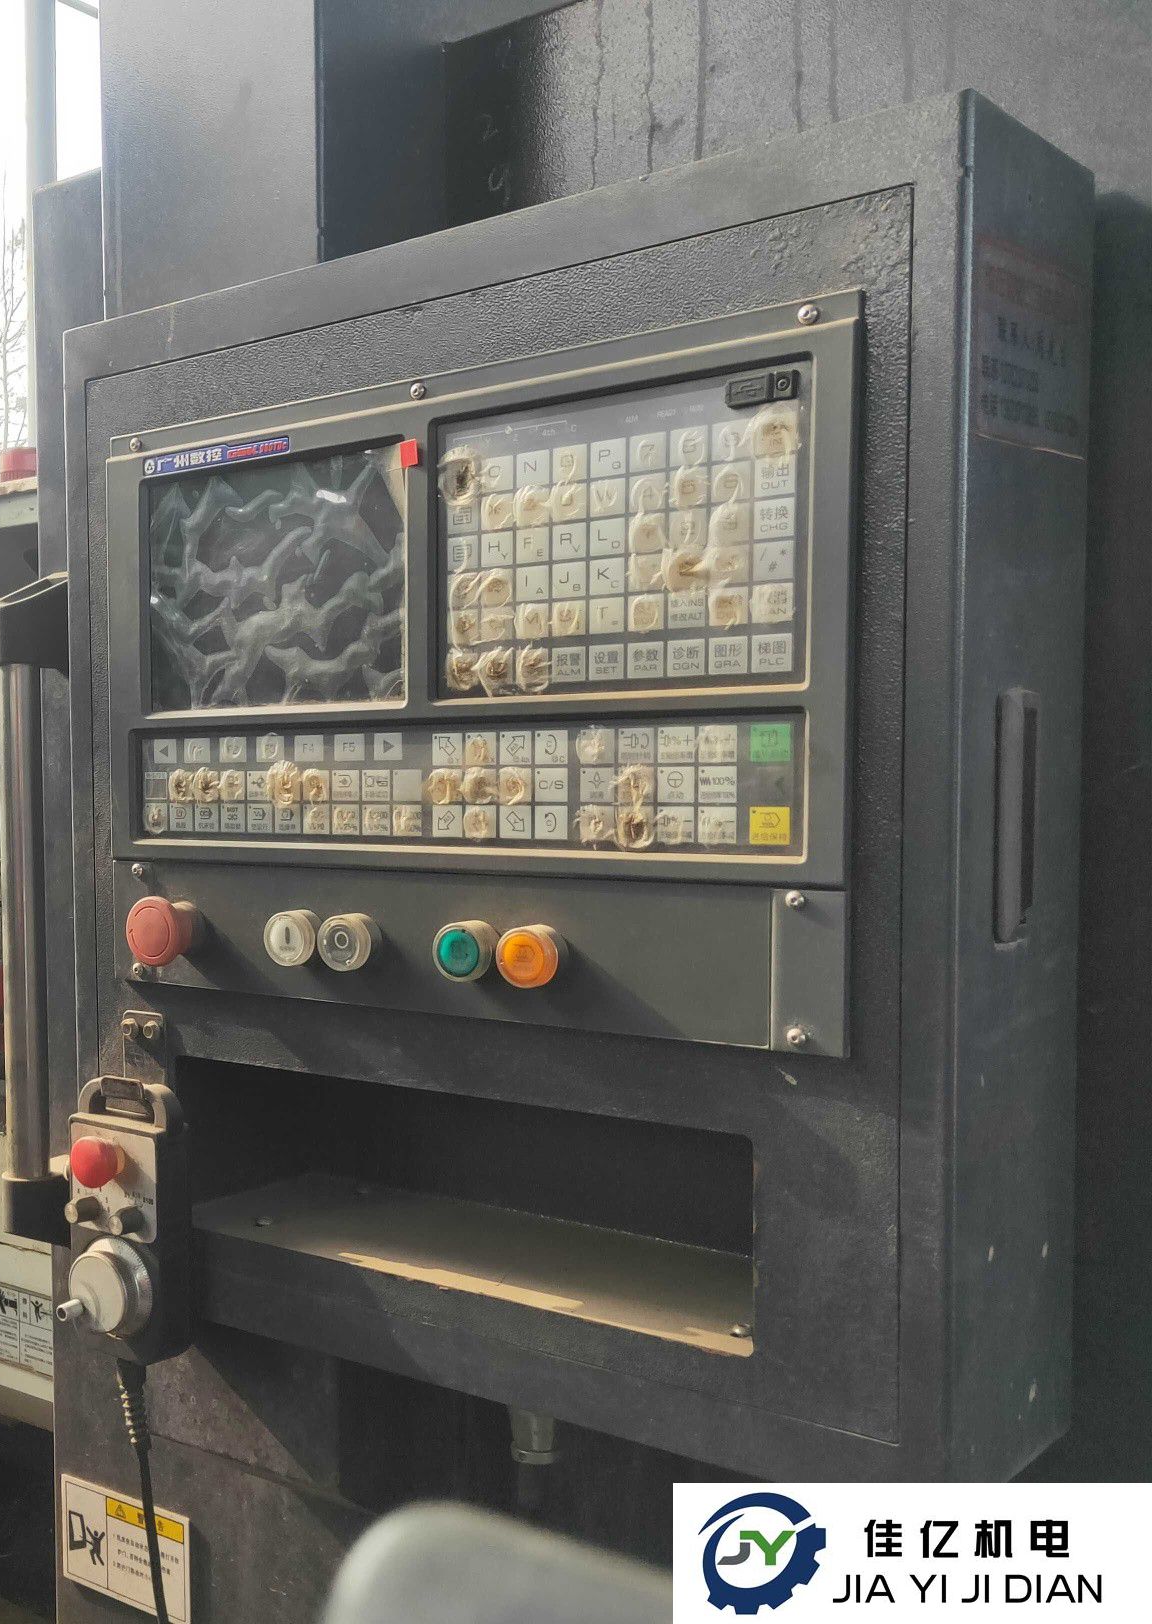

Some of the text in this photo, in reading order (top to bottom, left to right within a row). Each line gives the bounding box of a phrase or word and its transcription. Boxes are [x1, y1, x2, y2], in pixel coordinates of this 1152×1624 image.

[157, 447, 223, 472] 广州数控
[599, 449, 610, 462] P
[523, 460, 537, 473] N
[760, 480, 789, 490] OUT
[760, 523, 788, 533] CHG
[560, 533, 572, 545] R
[598, 529, 607, 541] L
[488, 541, 500, 554] H
[523, 537, 532, 550] F
[559, 571, 569, 584] J
[597, 567, 610, 581] K
[598, 607, 609, 619] T
[632, 649, 659, 663] 参数
[672, 646, 699, 660] 诊断
[714, 643, 742, 658] 图形
[556, 653, 582, 667] 报警
[594, 651, 619, 665] 设置
[714, 659, 742, 669] GRA
[758, 658, 785, 667] PLC
[557, 668, 581, 676] ALM
[595, 666, 617, 675] SET
[633, 663, 658, 672] PAR
[302, 743, 315, 753] F4
[342, 742, 355, 753] F5
[538, 780, 564, 790] C/S
